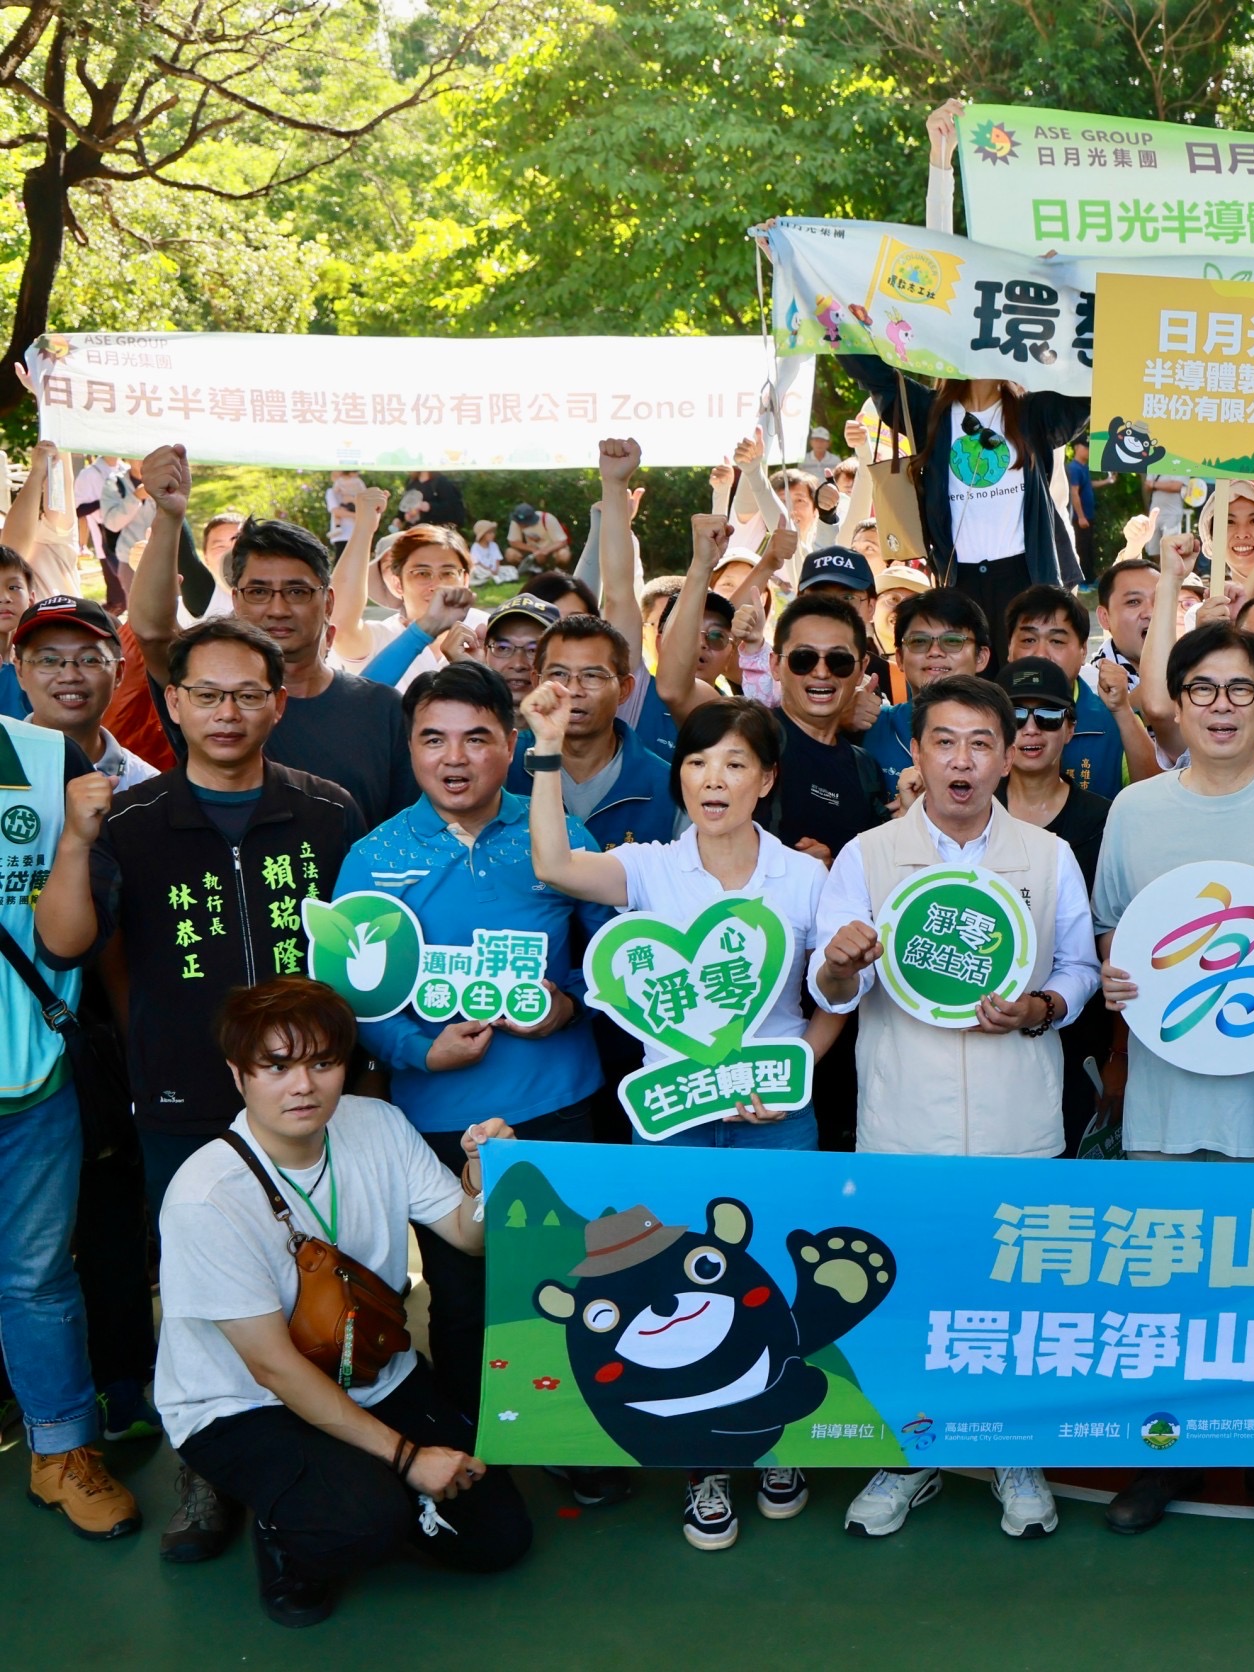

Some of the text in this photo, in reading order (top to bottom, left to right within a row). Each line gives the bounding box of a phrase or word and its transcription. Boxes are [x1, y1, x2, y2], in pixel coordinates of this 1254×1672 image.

[1034, 125, 1154, 147] ASE GROUP
[1037, 146, 1158, 169] 日月光集團
[84, 334, 168, 349] ASE GROUP
[86, 350, 172, 370] 日月光集團
[42, 374, 598, 427] 日月光半導體製造股份有限公司
[610, 394, 696, 421] Zone
[976, 490, 988, 499] no
[990, 485, 1019, 499] planet
[813, 555, 856, 570] TPGA
[202, 871, 227, 937] 執行長
[262, 854, 304, 975] 賴瑞隆
[168, 883, 206, 980] 林恭正
[923, 902, 998, 950] 淨零
[422, 933, 545, 980] 邁向淨零
[903, 936, 993, 987] 綠生活
[423, 982, 541, 1013] 綠生活
[641, 955, 757, 1028] 淨零
[643, 1058, 792, 1122] 生活轉型
[811, 1423, 875, 1440] 指導單位
[944, 1421, 1004, 1433] 高雄市政府
[944, 1434, 978, 1442] Kaohsiung
[979, 1434, 992, 1442] City
[1058, 1422, 1121, 1439] 主辦單位
[1185, 1432, 1232, 1440] Environmental
